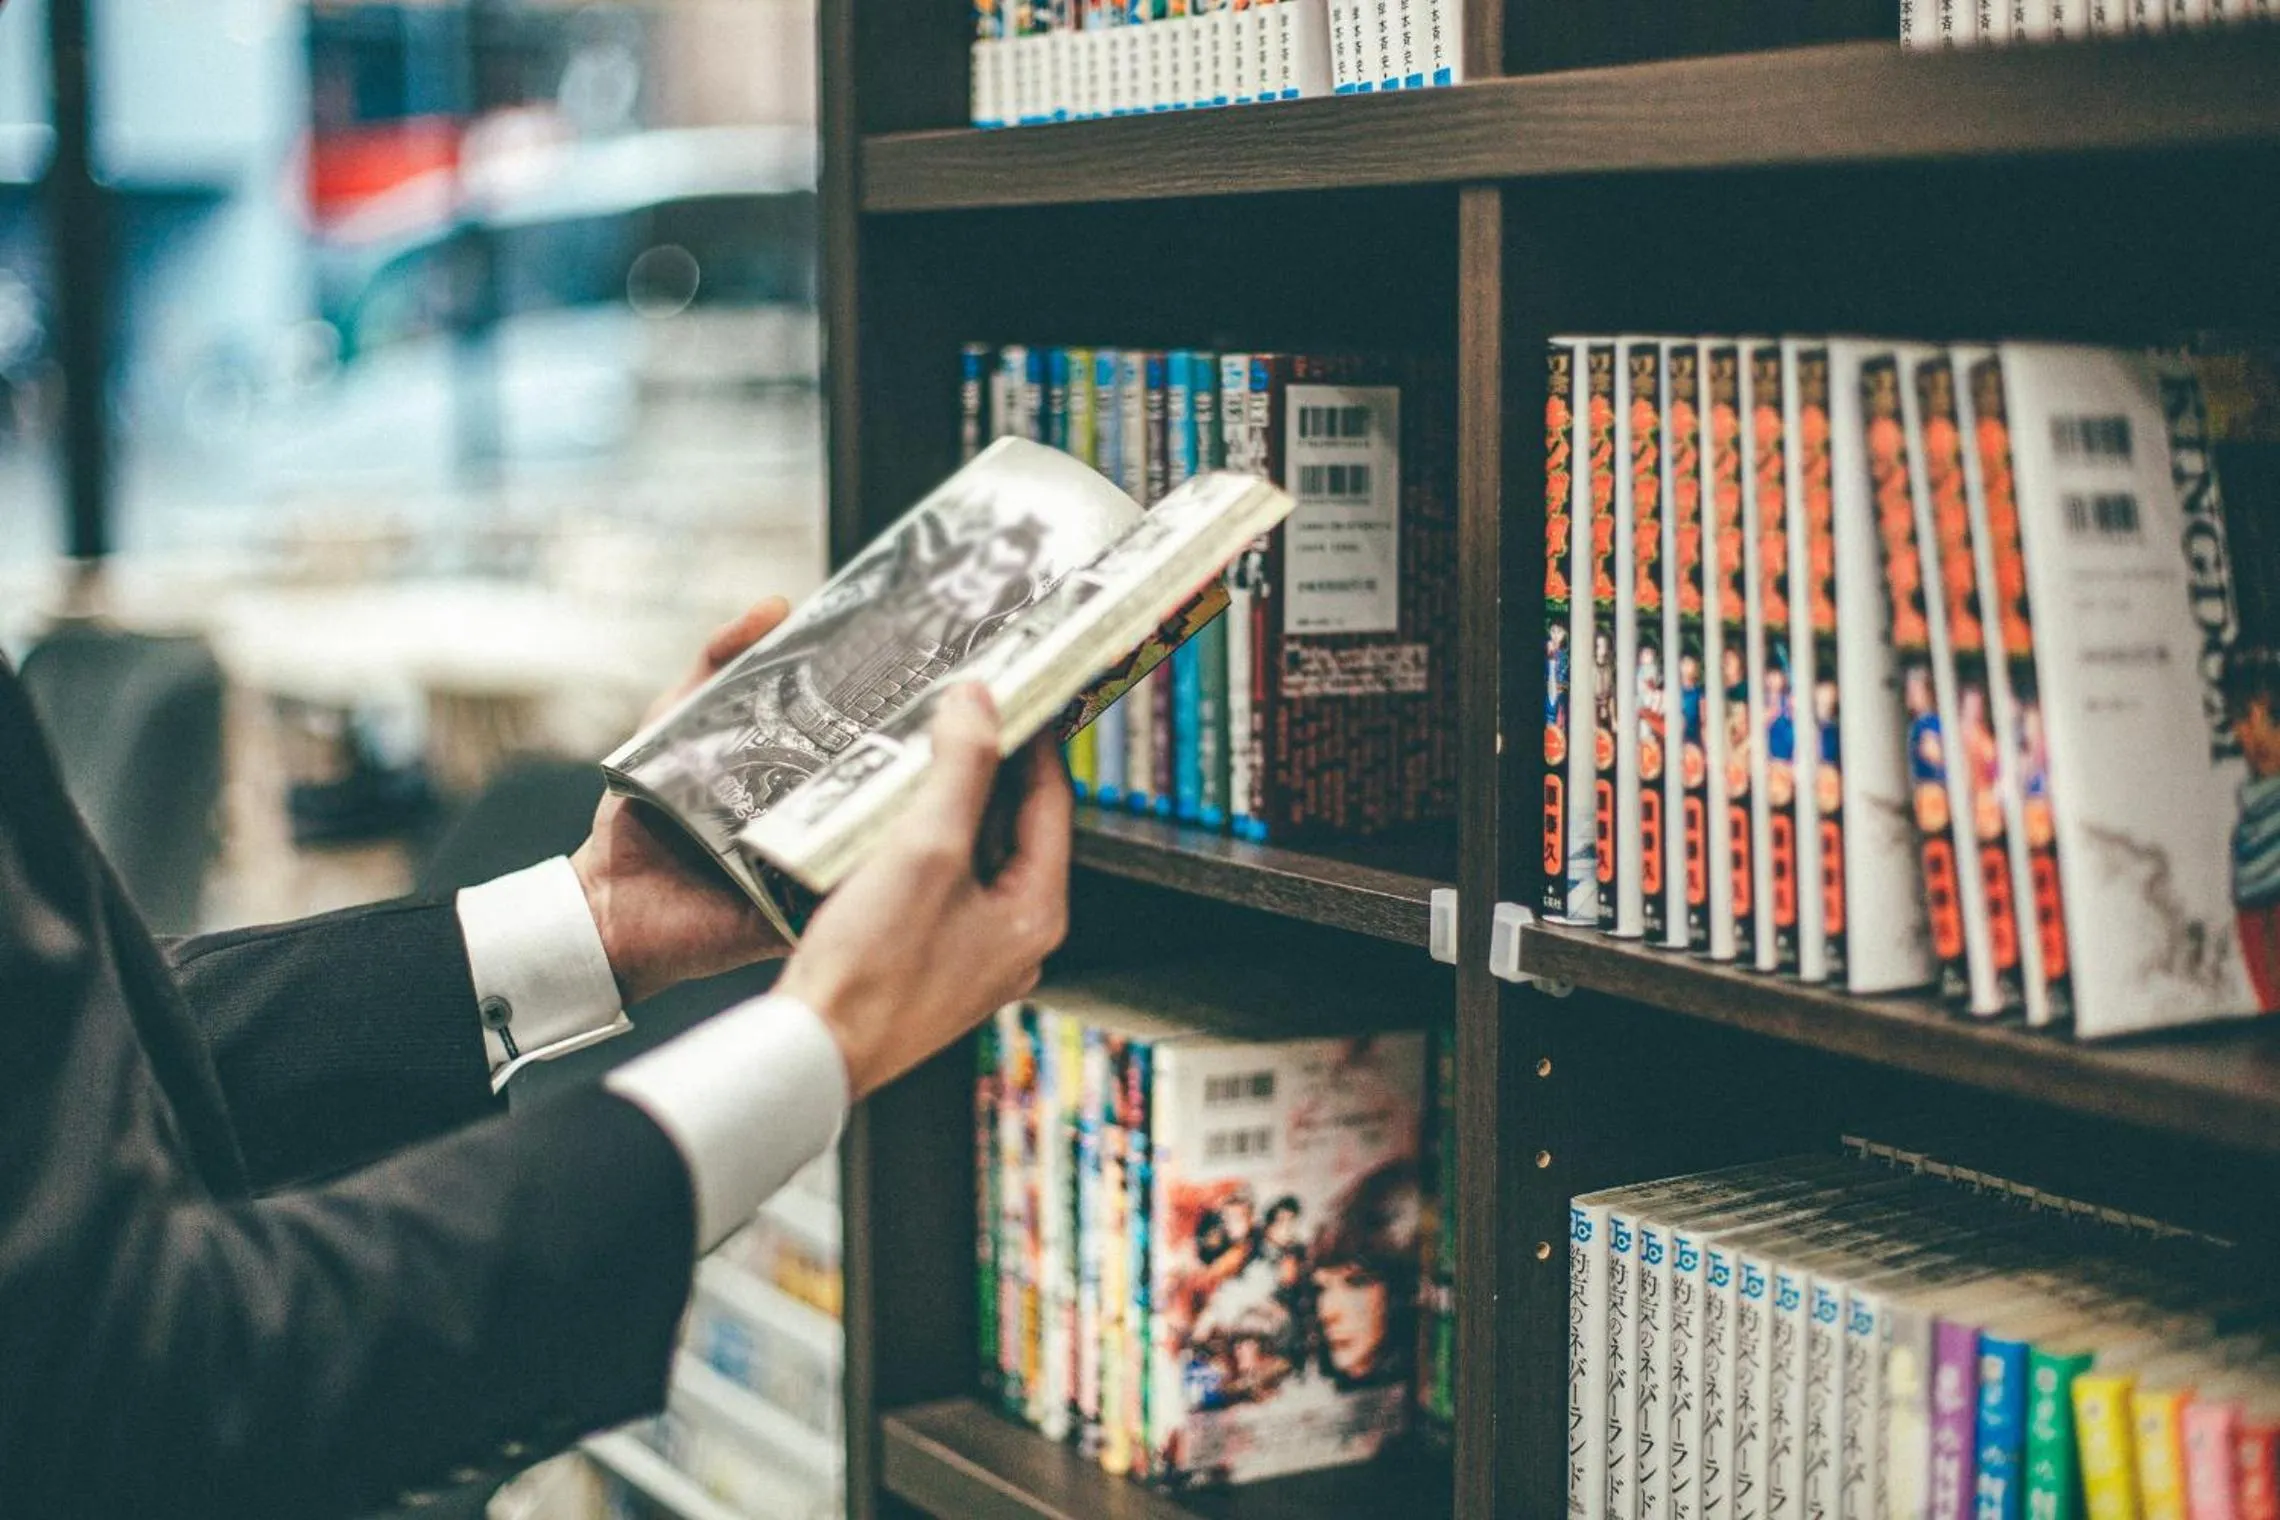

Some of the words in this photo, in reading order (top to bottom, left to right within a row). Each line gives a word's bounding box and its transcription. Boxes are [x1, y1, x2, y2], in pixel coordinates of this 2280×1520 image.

[1569, 1244, 1589, 1491] 約束のネバーランド
[1608, 1255, 1628, 1503] 約束のネバーランド
[1639, 1267, 1660, 1518] 約束のネバーランド
[1704, 1288, 1726, 1520] 約束のネバーラン
